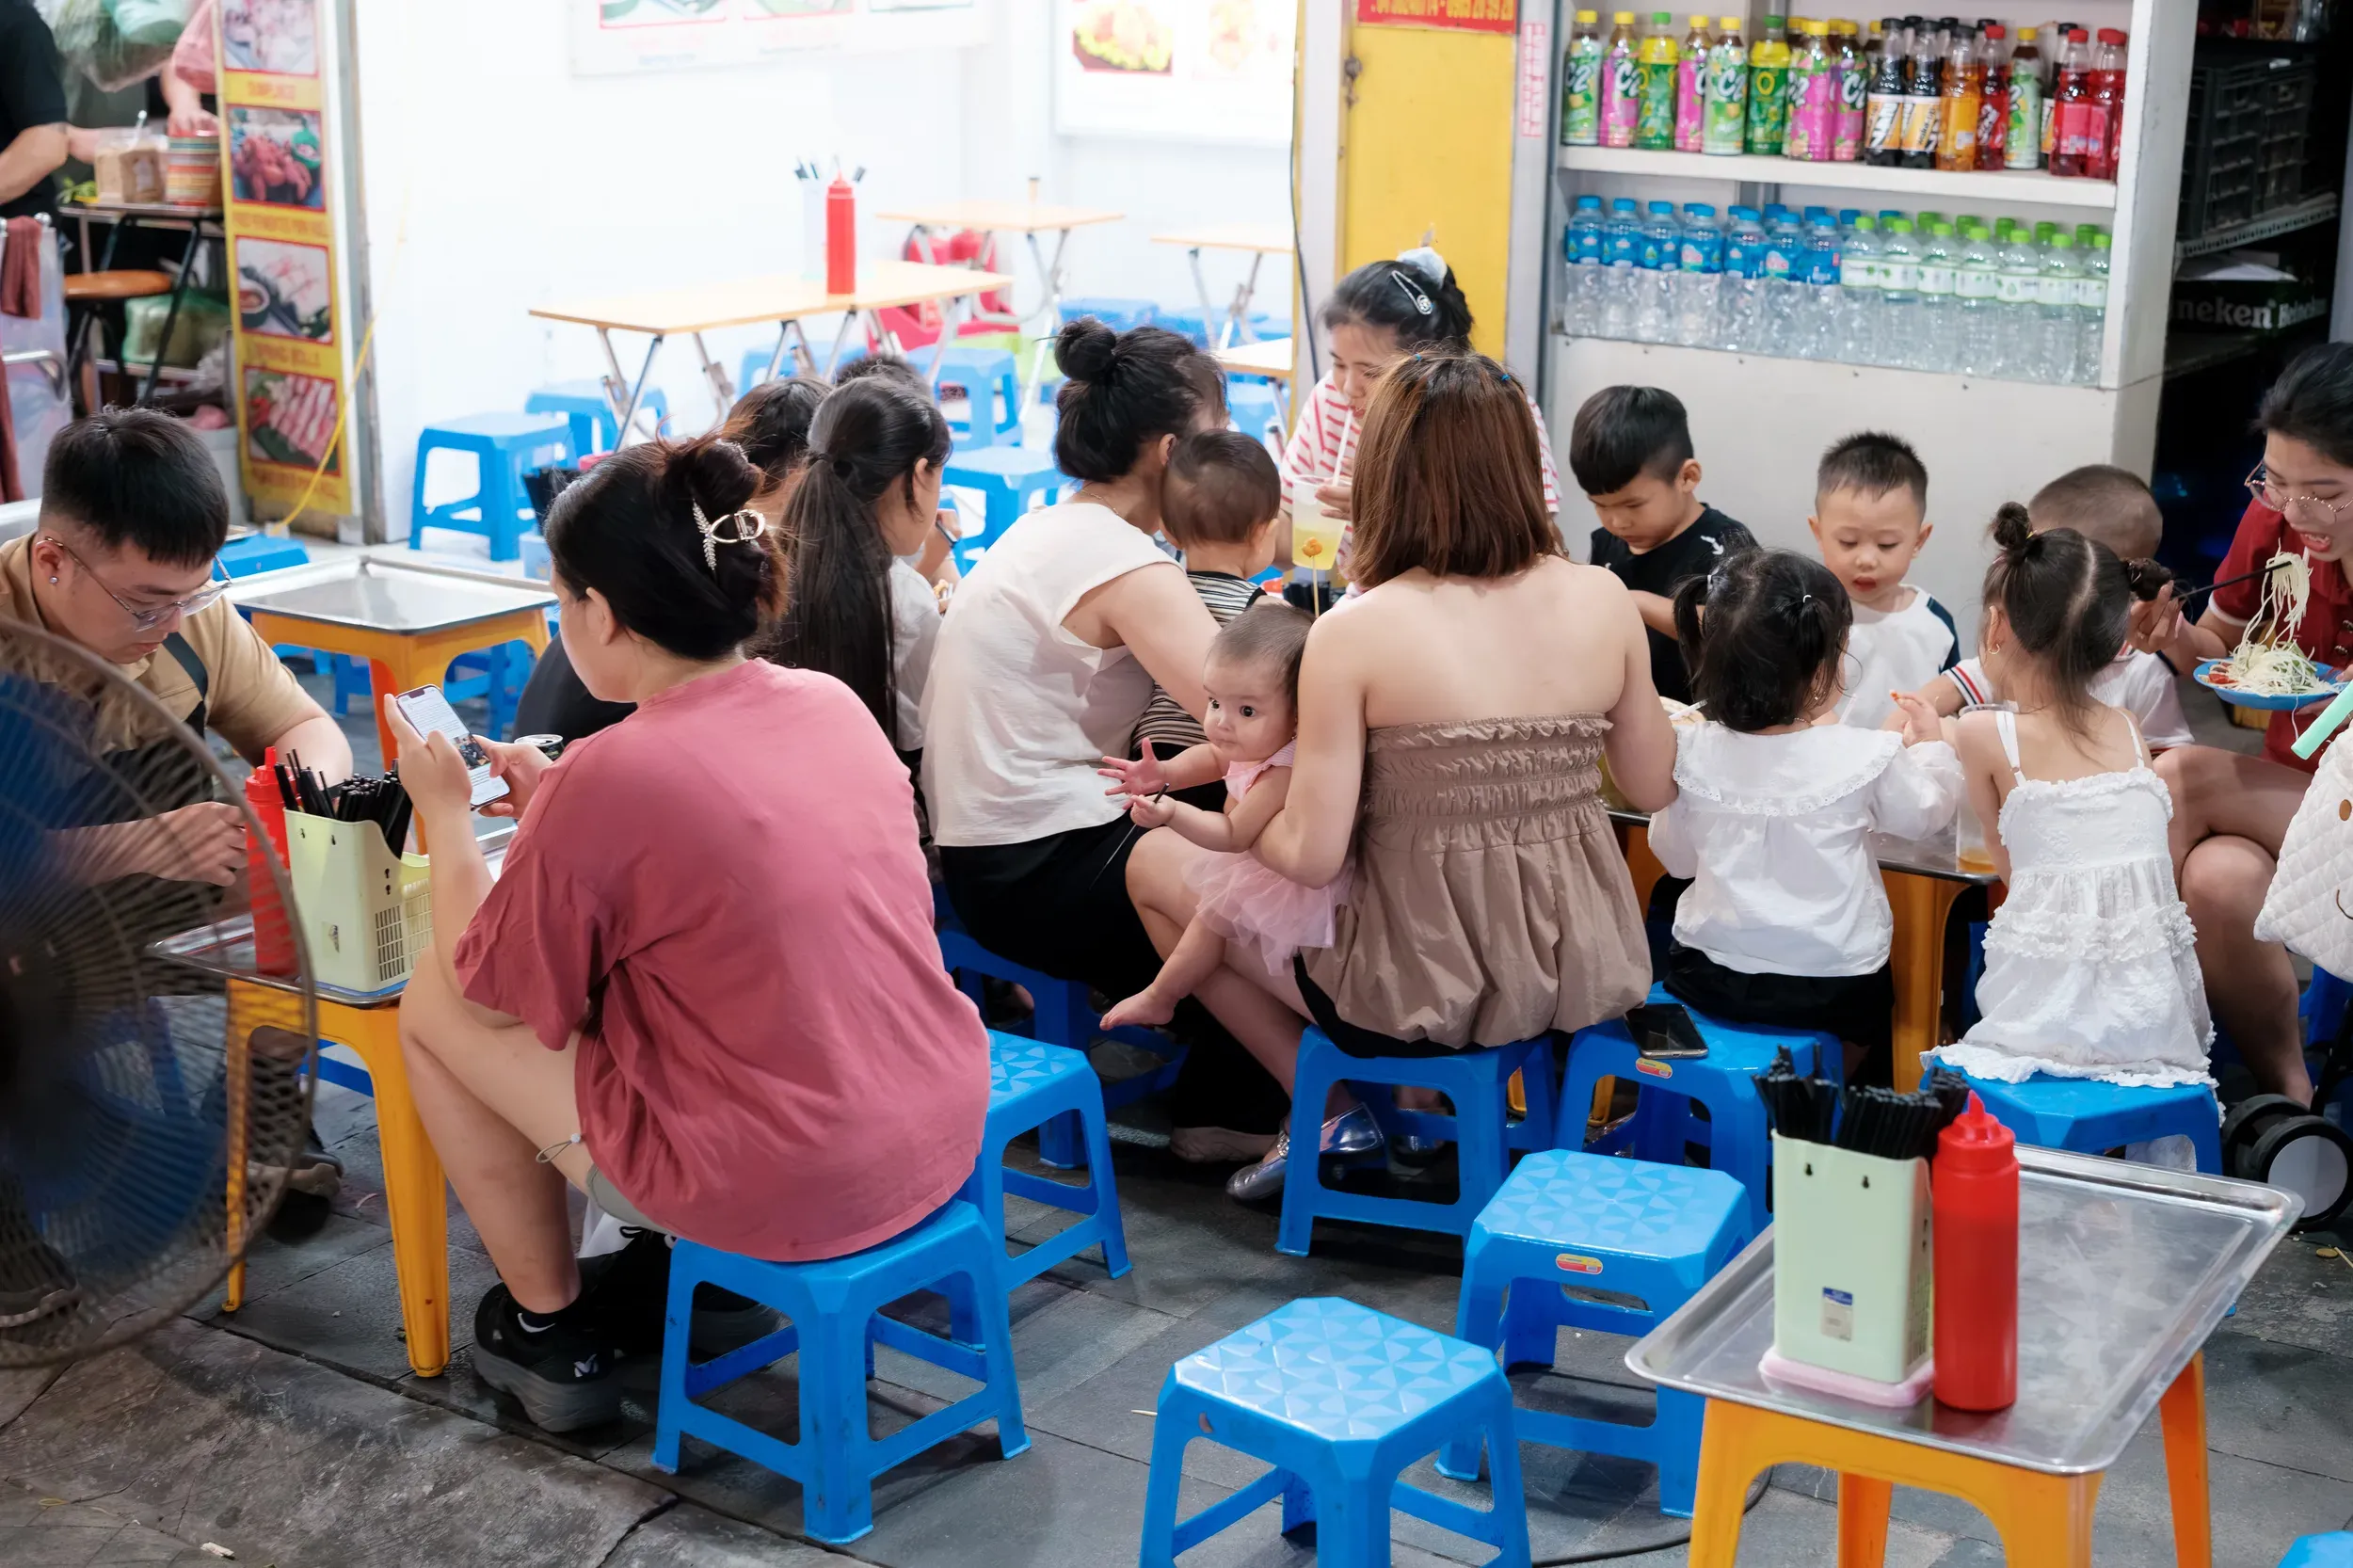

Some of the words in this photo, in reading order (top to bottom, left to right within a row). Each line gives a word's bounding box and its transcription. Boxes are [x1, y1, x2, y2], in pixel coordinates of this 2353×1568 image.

[1567, 62, 1592, 94] C2
[1718, 68, 1746, 102] C2
[2175, 295, 2272, 329] neken
